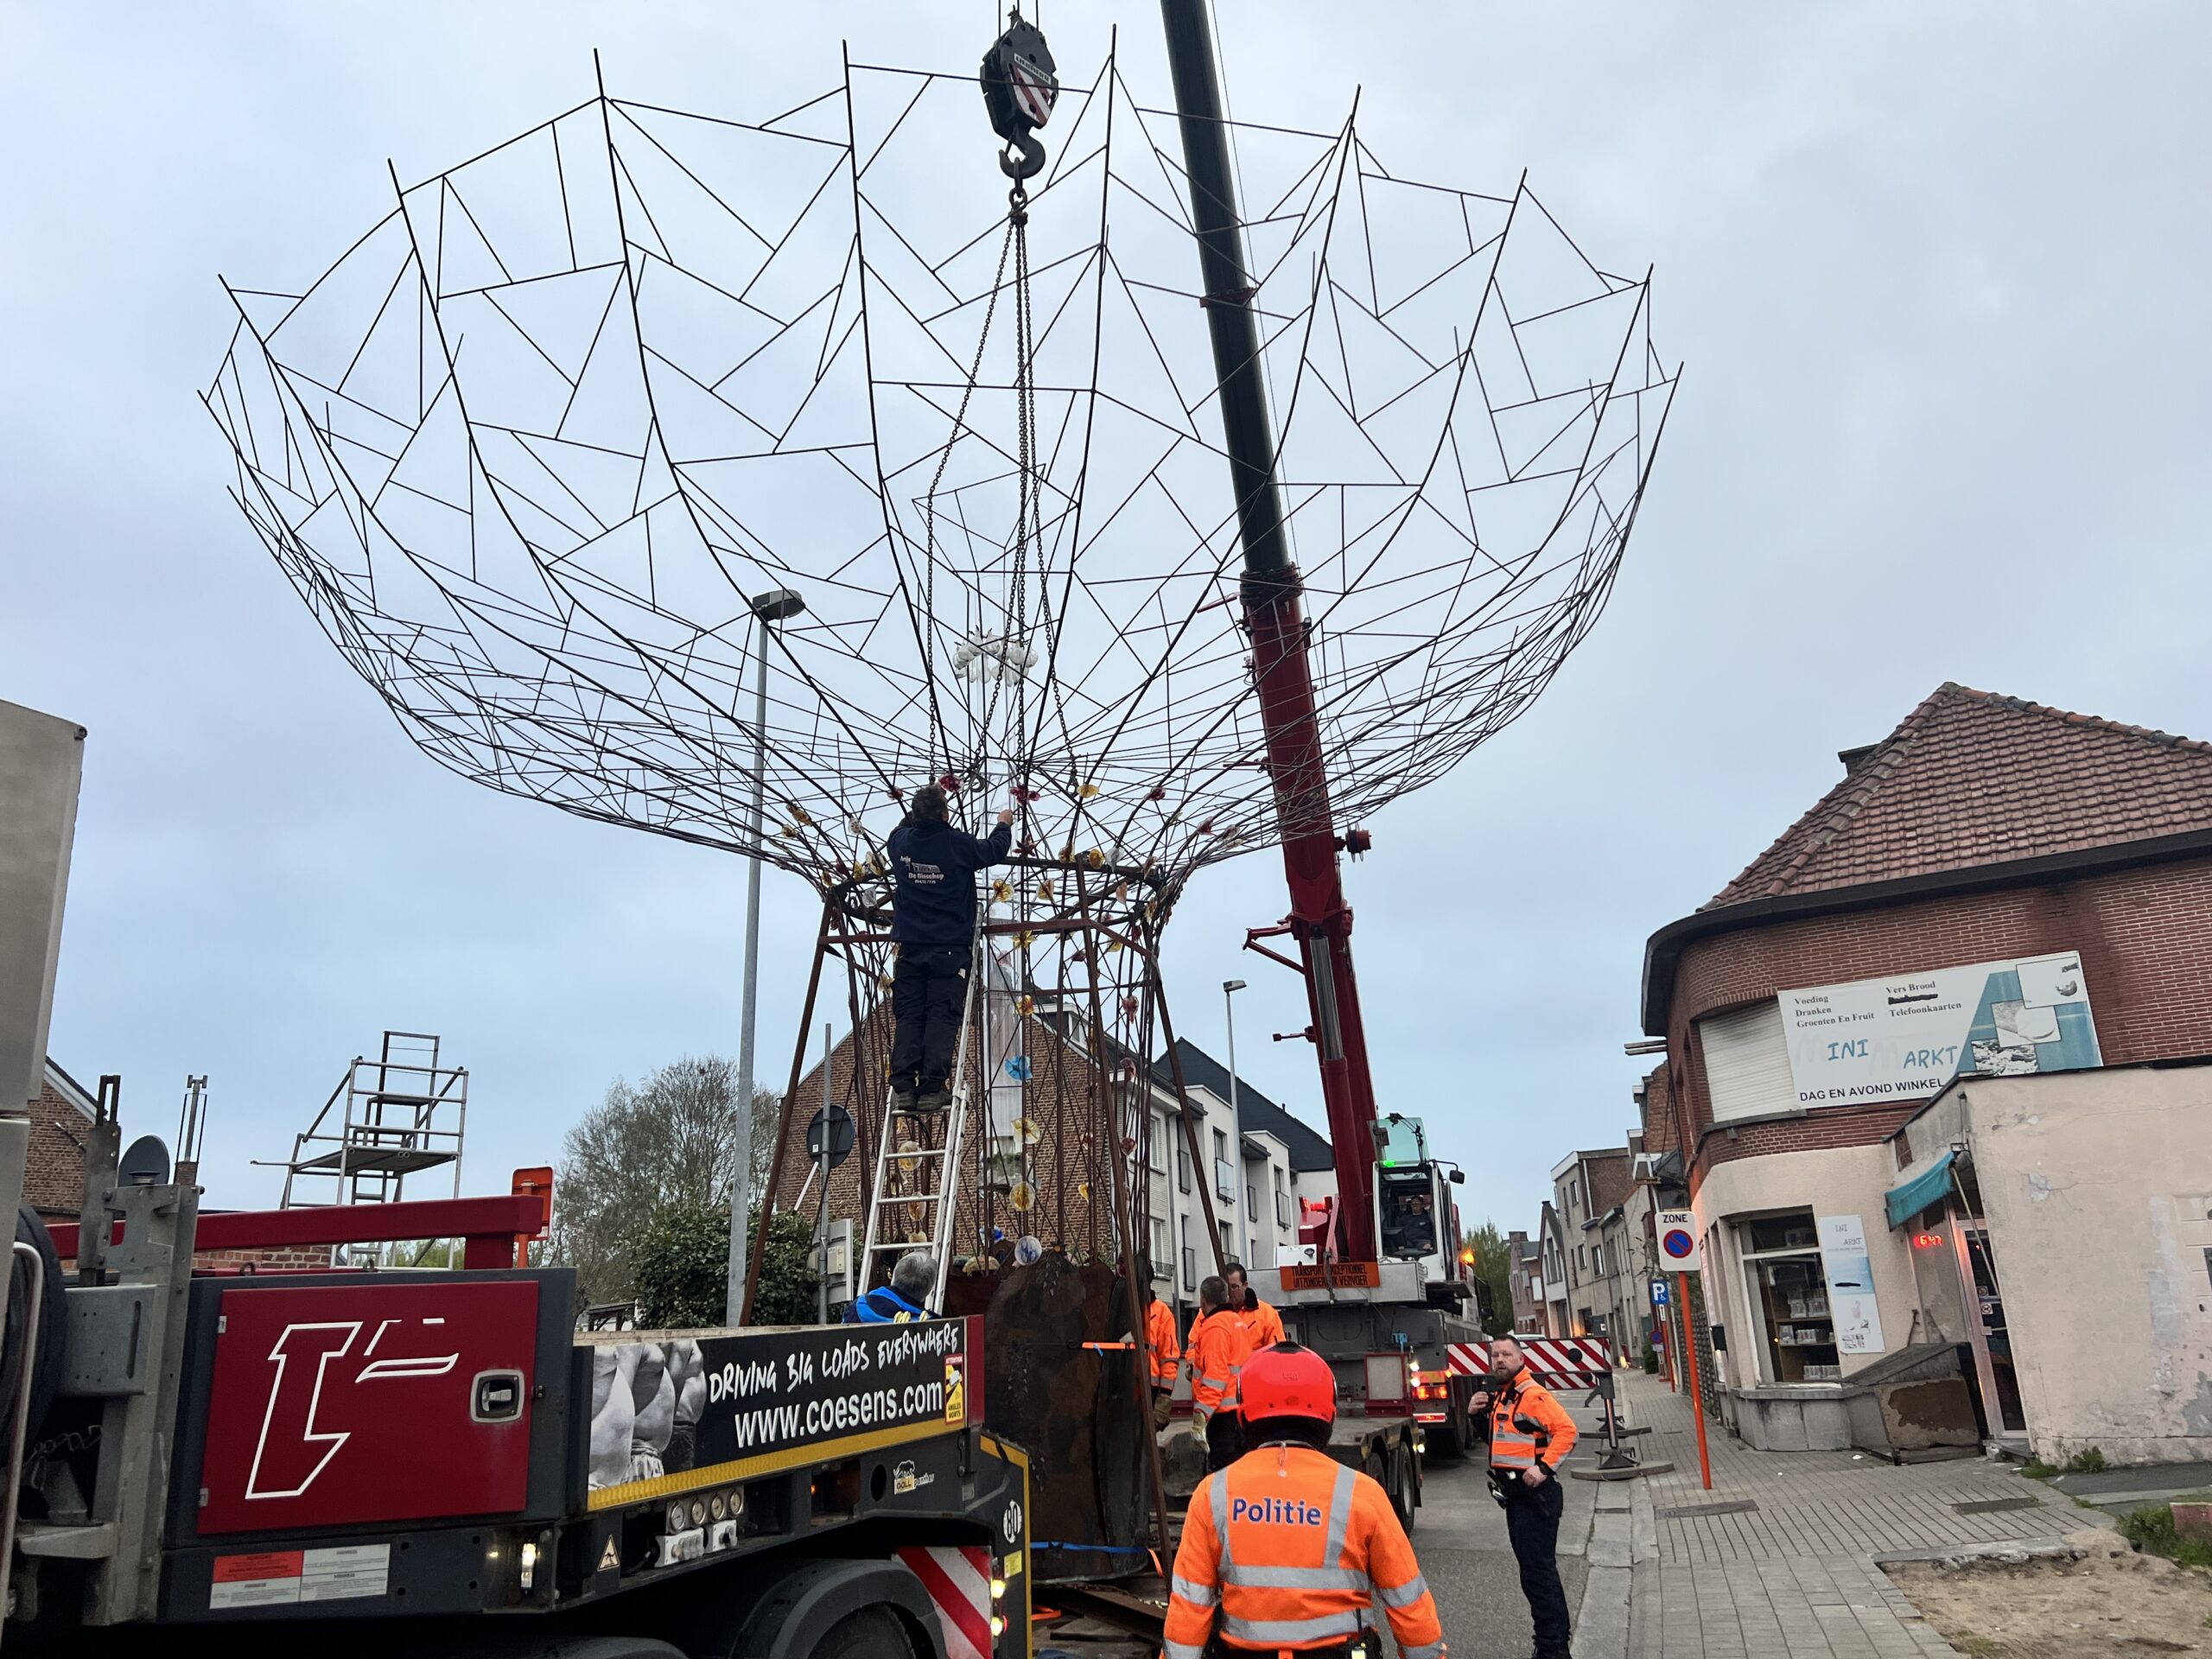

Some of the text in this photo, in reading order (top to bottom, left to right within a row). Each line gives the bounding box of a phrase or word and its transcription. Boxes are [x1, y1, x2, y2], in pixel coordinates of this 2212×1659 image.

[1885, 981, 1936, 995] Vers Brood
[1795, 995, 1829, 1006] Voeding
[1796, 1007, 1832, 1017] Dranken
[1889, 1002, 1962, 1017] Telefoonkaarten
[1797, 1012, 1875, 1028] Groenten En Fruit
[1800, 1078, 1945, 1102] DAG EN AVOND WINKEL
[1662, 1214, 1688, 1224] ZONE
[1293, 1263, 1368, 1277] TRANSPORT XCEPTIONNEL
[1339, 1275, 1369, 1286] VERVOER
[1652, 1283, 1666, 1301] P
[709, 1323, 959, 1403] DRIVING BIG LOADS EVERYWHERE
[734, 1382, 943, 1448] www.coesens.com
[896, 1480, 912, 1490] DOLL
[1233, 1497, 1321, 1525] Politie
[1007, 1503, 1019, 1540] 80
